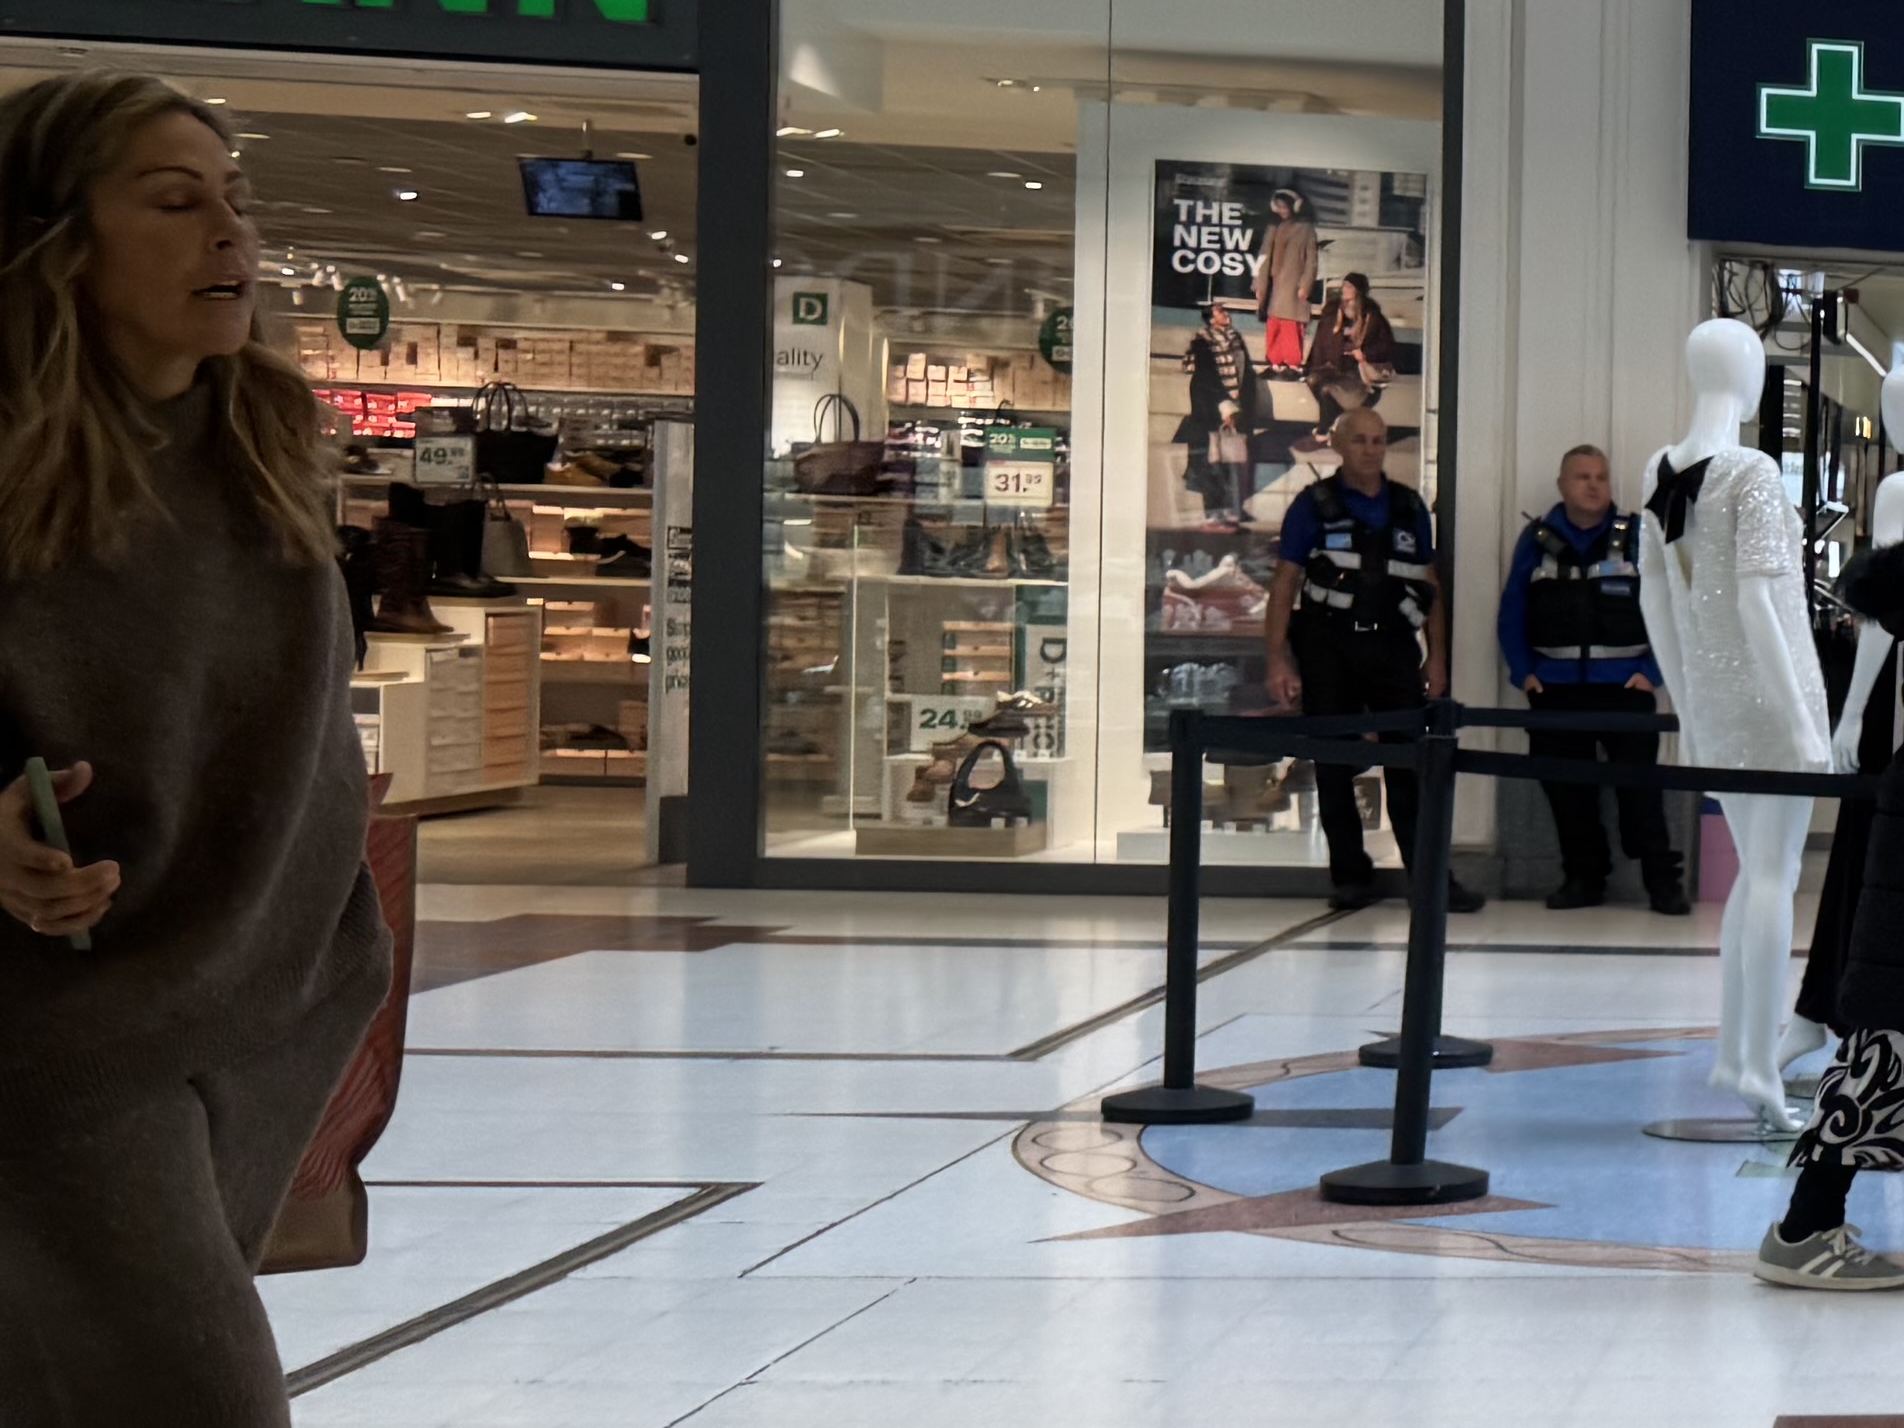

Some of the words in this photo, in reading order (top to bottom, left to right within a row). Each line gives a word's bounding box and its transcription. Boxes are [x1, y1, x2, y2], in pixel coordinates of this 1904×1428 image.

[1173, 198, 1244, 225] THE
[1173, 224, 1254, 251] NEW
[1171, 249, 1268, 277] COSY
